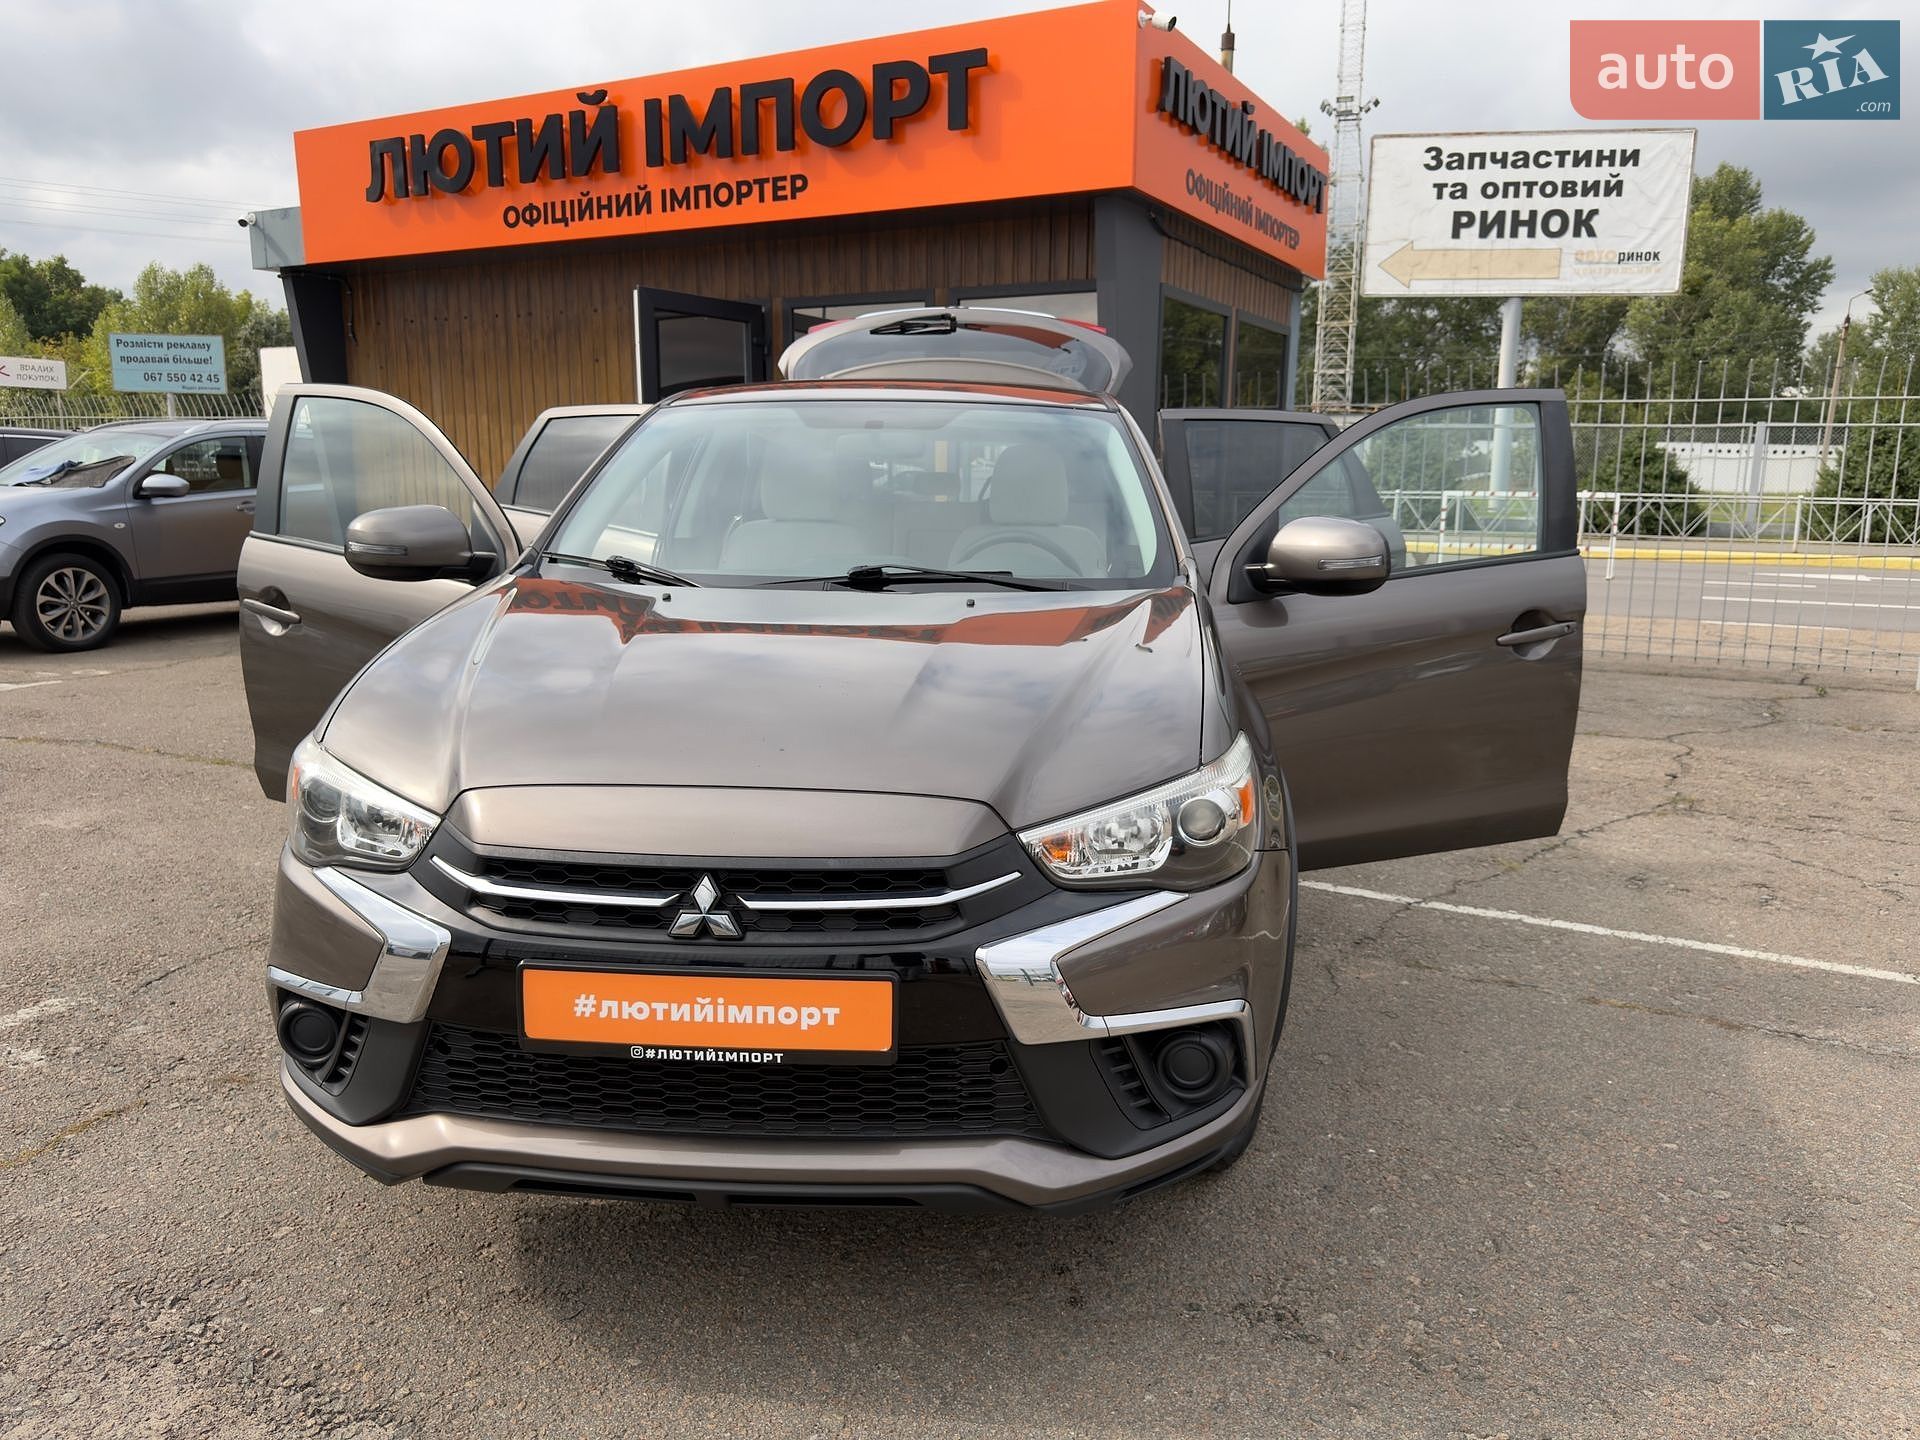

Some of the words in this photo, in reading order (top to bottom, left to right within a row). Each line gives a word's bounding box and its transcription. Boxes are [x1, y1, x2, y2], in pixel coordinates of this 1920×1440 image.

[366, 89, 620, 203] ЛЮТИЙ
[644, 47, 988, 168] ІМПОРТ
[1160, 56, 1257, 169] ЛЮТИЙ
[1258, 129, 1327, 214] ІМПОРТ
[1423, 146, 1641, 171] Запчастини
[1432, 182, 1468, 200] та
[1480, 173, 1624, 199] оптовий
[503, 184, 652, 229] ОФІЦІЙНИЙ
[661, 174, 809, 213] ІМПОРТЕР
[1186, 168, 1253, 226] ОФІЦІЙНИЙ
[1254, 208, 1300, 249] ІМПОРТЕР
[1451, 208, 1600, 239] РИНОК
[116, 338, 164, 349] Розмісти
[167, 340, 211, 352] рекламу
[120, 354, 170, 364] продавай
[172, 354, 213, 365] більше!
[143, 372, 163, 382] 067
[166, 372, 187, 383] 550
[189, 373, 204, 383] 42
[206, 374, 220, 384] 45
[573, 994, 841, 1030] #лютийімпорт
[645, 1048, 784, 1063] #ЛЮТИЙІМПОРТ
